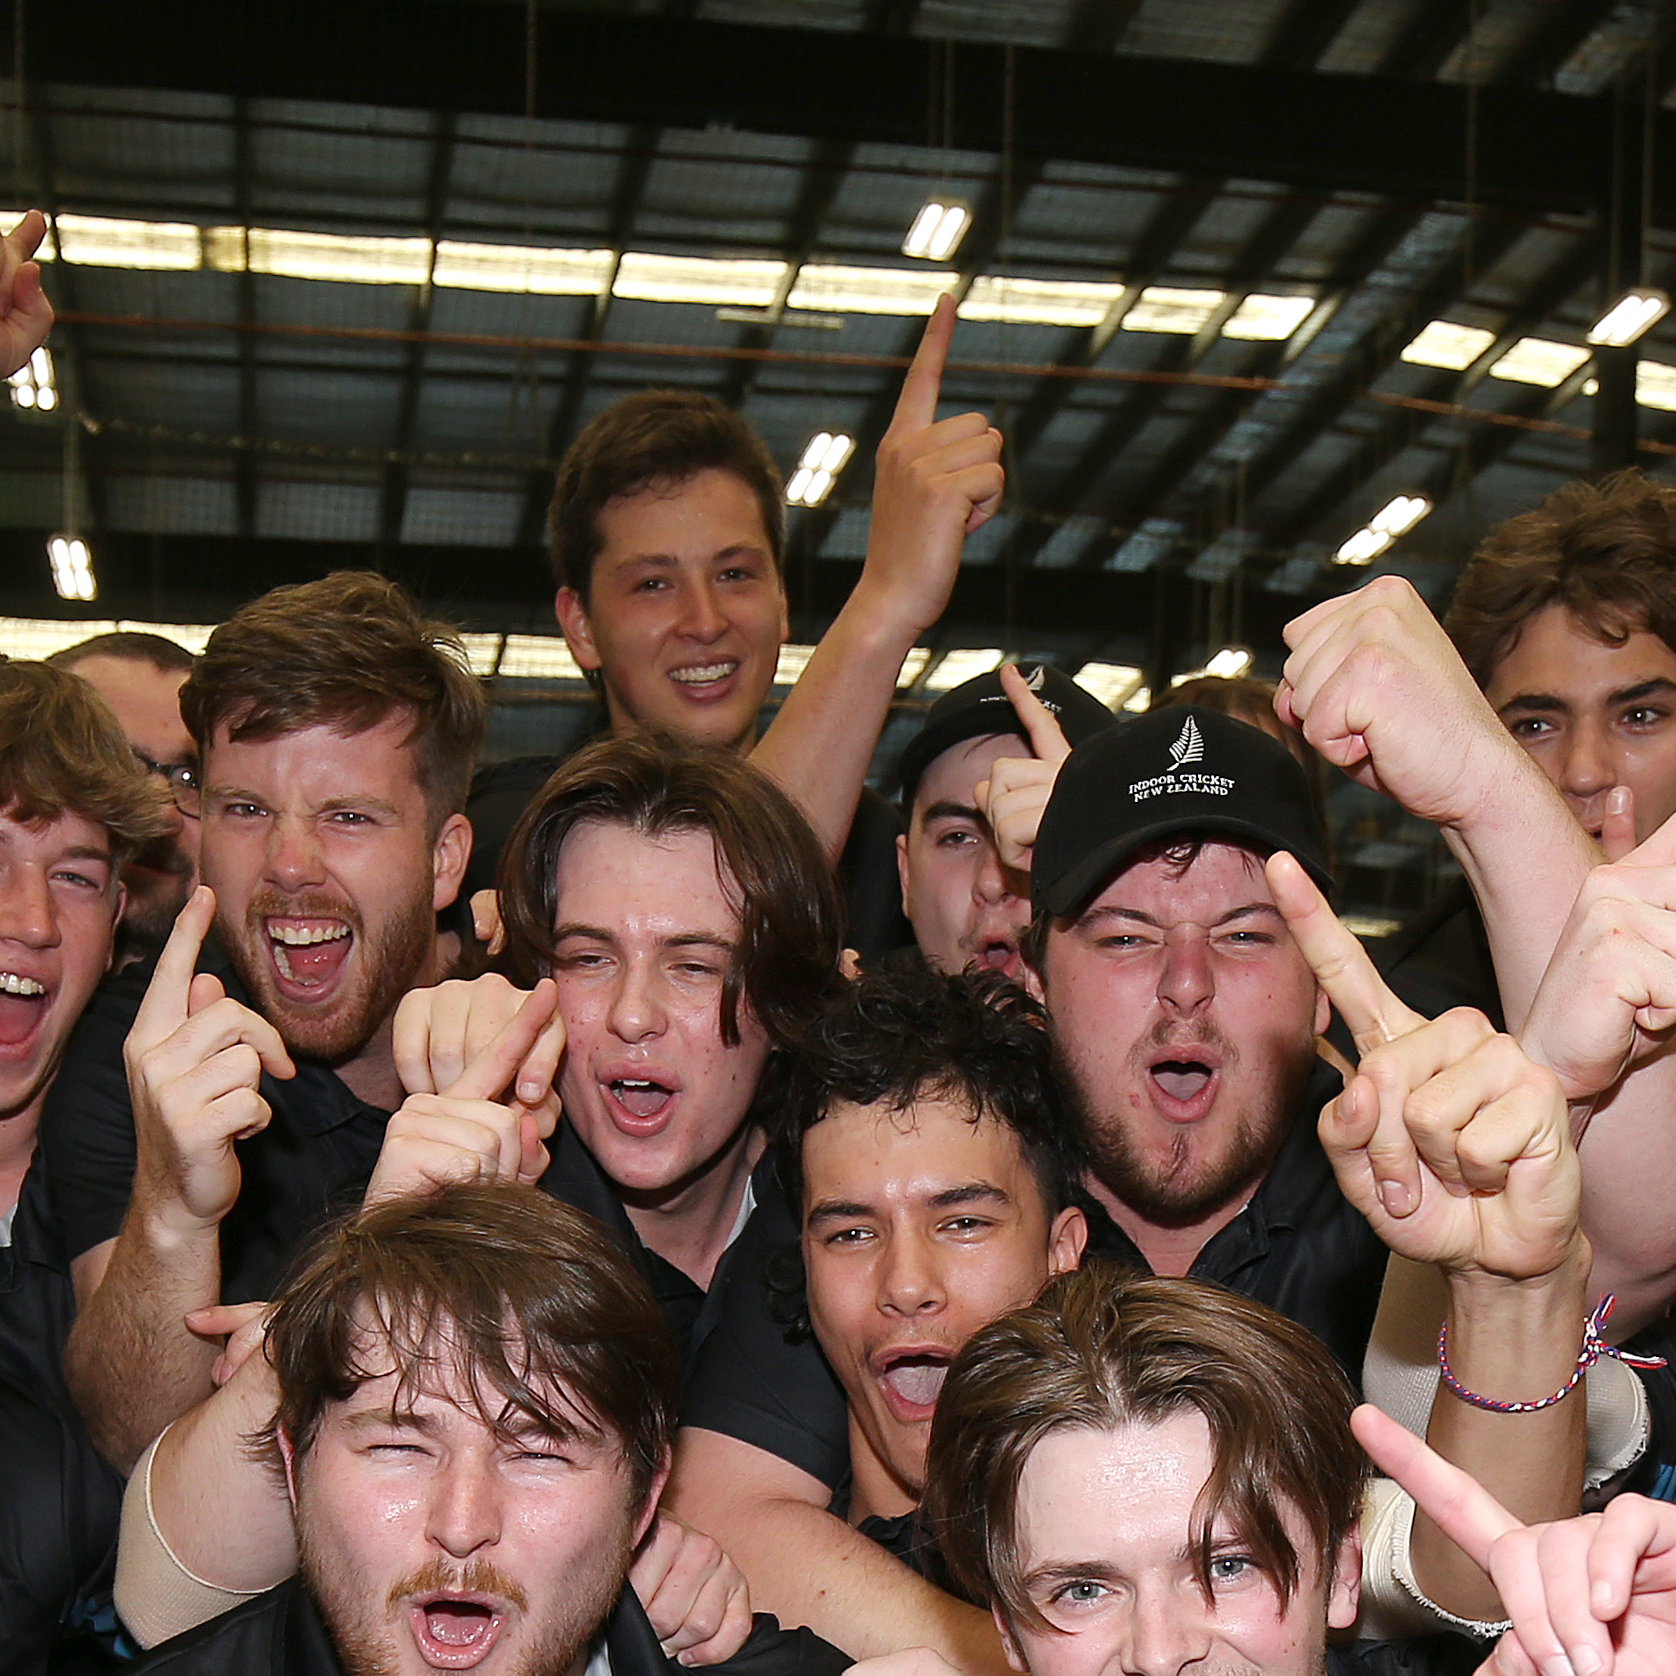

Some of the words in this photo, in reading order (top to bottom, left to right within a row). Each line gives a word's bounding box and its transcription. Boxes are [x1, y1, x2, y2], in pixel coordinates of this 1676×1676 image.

[1128, 774, 1176, 795] INDOOR
[1179, 773, 1236, 789] CRICKET
[1134, 785, 1164, 803] NEW
[1166, 782, 1229, 796] ZEALAND
